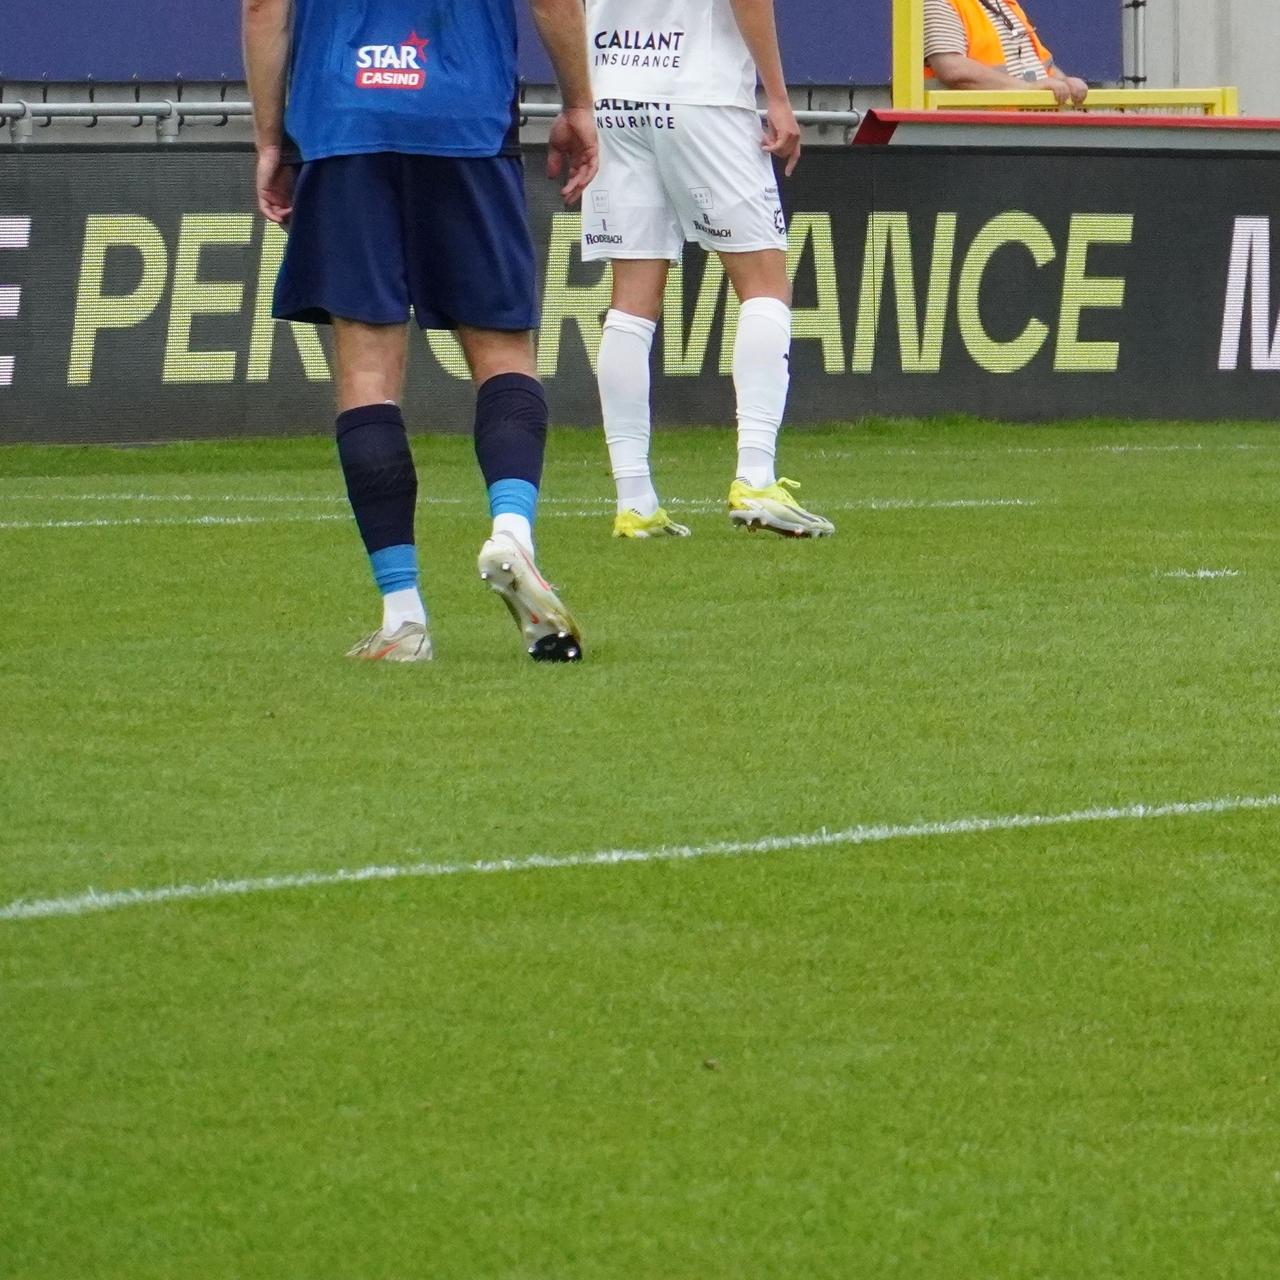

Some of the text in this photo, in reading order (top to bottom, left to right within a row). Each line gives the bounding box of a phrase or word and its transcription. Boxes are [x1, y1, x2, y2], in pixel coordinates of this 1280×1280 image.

[594, 30, 685, 51] CALLANT
[356, 45, 420, 69] STAR
[595, 53, 681, 68] INSURANCE
[362, 72, 420, 86] CASINO
